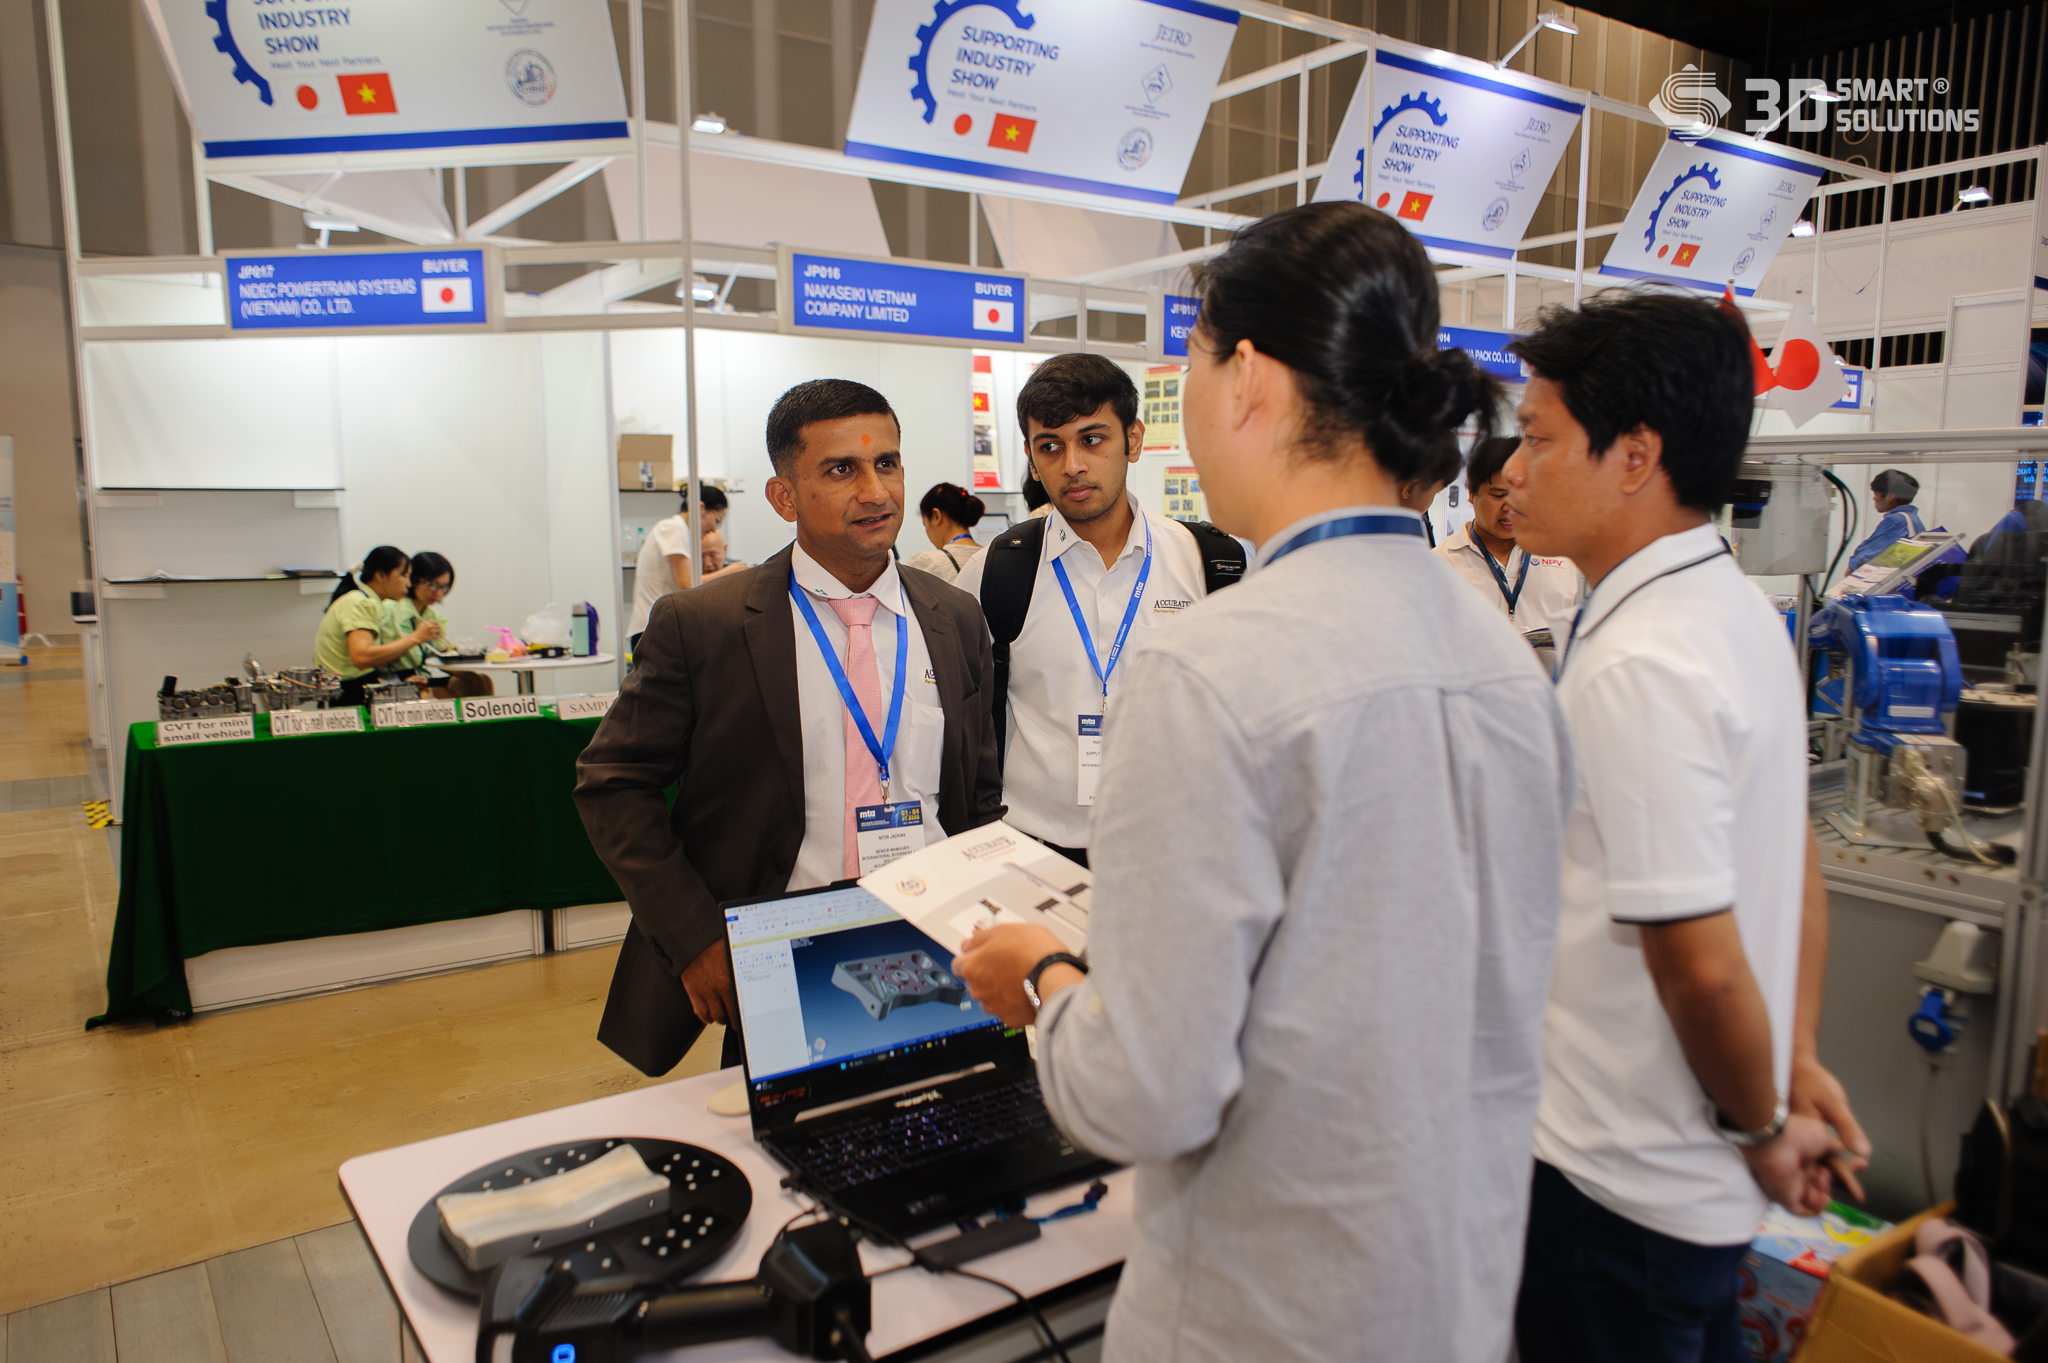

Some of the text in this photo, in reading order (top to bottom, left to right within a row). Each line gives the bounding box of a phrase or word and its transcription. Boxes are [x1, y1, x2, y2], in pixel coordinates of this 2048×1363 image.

[257, 7, 351, 30] INDUSTRY
[961, 25, 1060, 60] SUPPORTING
[1152, 23, 1192, 47] JETRO
[264, 34, 320, 55] SHOW
[955, 47, 1036, 77] INDUSTRY
[951, 68, 999, 91] SHOW
[1523, 117, 1551, 135] JETRO
[1396, 124, 1460, 149] SUPPORTING
[1389, 141, 1441, 163] INDUSTRY
[1382, 157, 1415, 174] SHOW
[1776, 180, 1796, 194] JETRO
[1681, 190, 1728, 208] SUPPORTING
[1674, 203, 1712, 219] INDUSTRY
[1667, 216, 1691, 230] SHOW
[238, 264, 275, 280] JP017
[421, 258, 470, 274] BUYER
[803, 264, 842, 280] JP016
[239, 277, 418, 299] NIDEC POWERTRAIN SYSTEMS
[804, 283, 917, 307] NAKASEIKI VIETNAM
[974, 281, 1013, 298] BUYER
[240, 299, 300, 320] (VIETNAM)
[804, 300, 910, 324] COMPANY LIMITED
[1475, 349, 1492, 362] PACK
[1504, 352, 1517, 364] LTD
[1541, 558, 1563, 567] NPV
[1134, 581, 1144, 599] mta
[377, 706, 394, 726] CVT
[407, 704, 423, 723] mini
[423, 704, 454, 722] vehicles
[465, 698, 537, 718] Solenoid
[164, 718, 249, 733] CVT for mini
[273, 714, 290, 734] CVT
[291, 713, 304, 732] for
[325, 712, 357, 731] vehicles
[163, 728, 252, 744] small vehicle
[859, 809, 876, 818] mta
